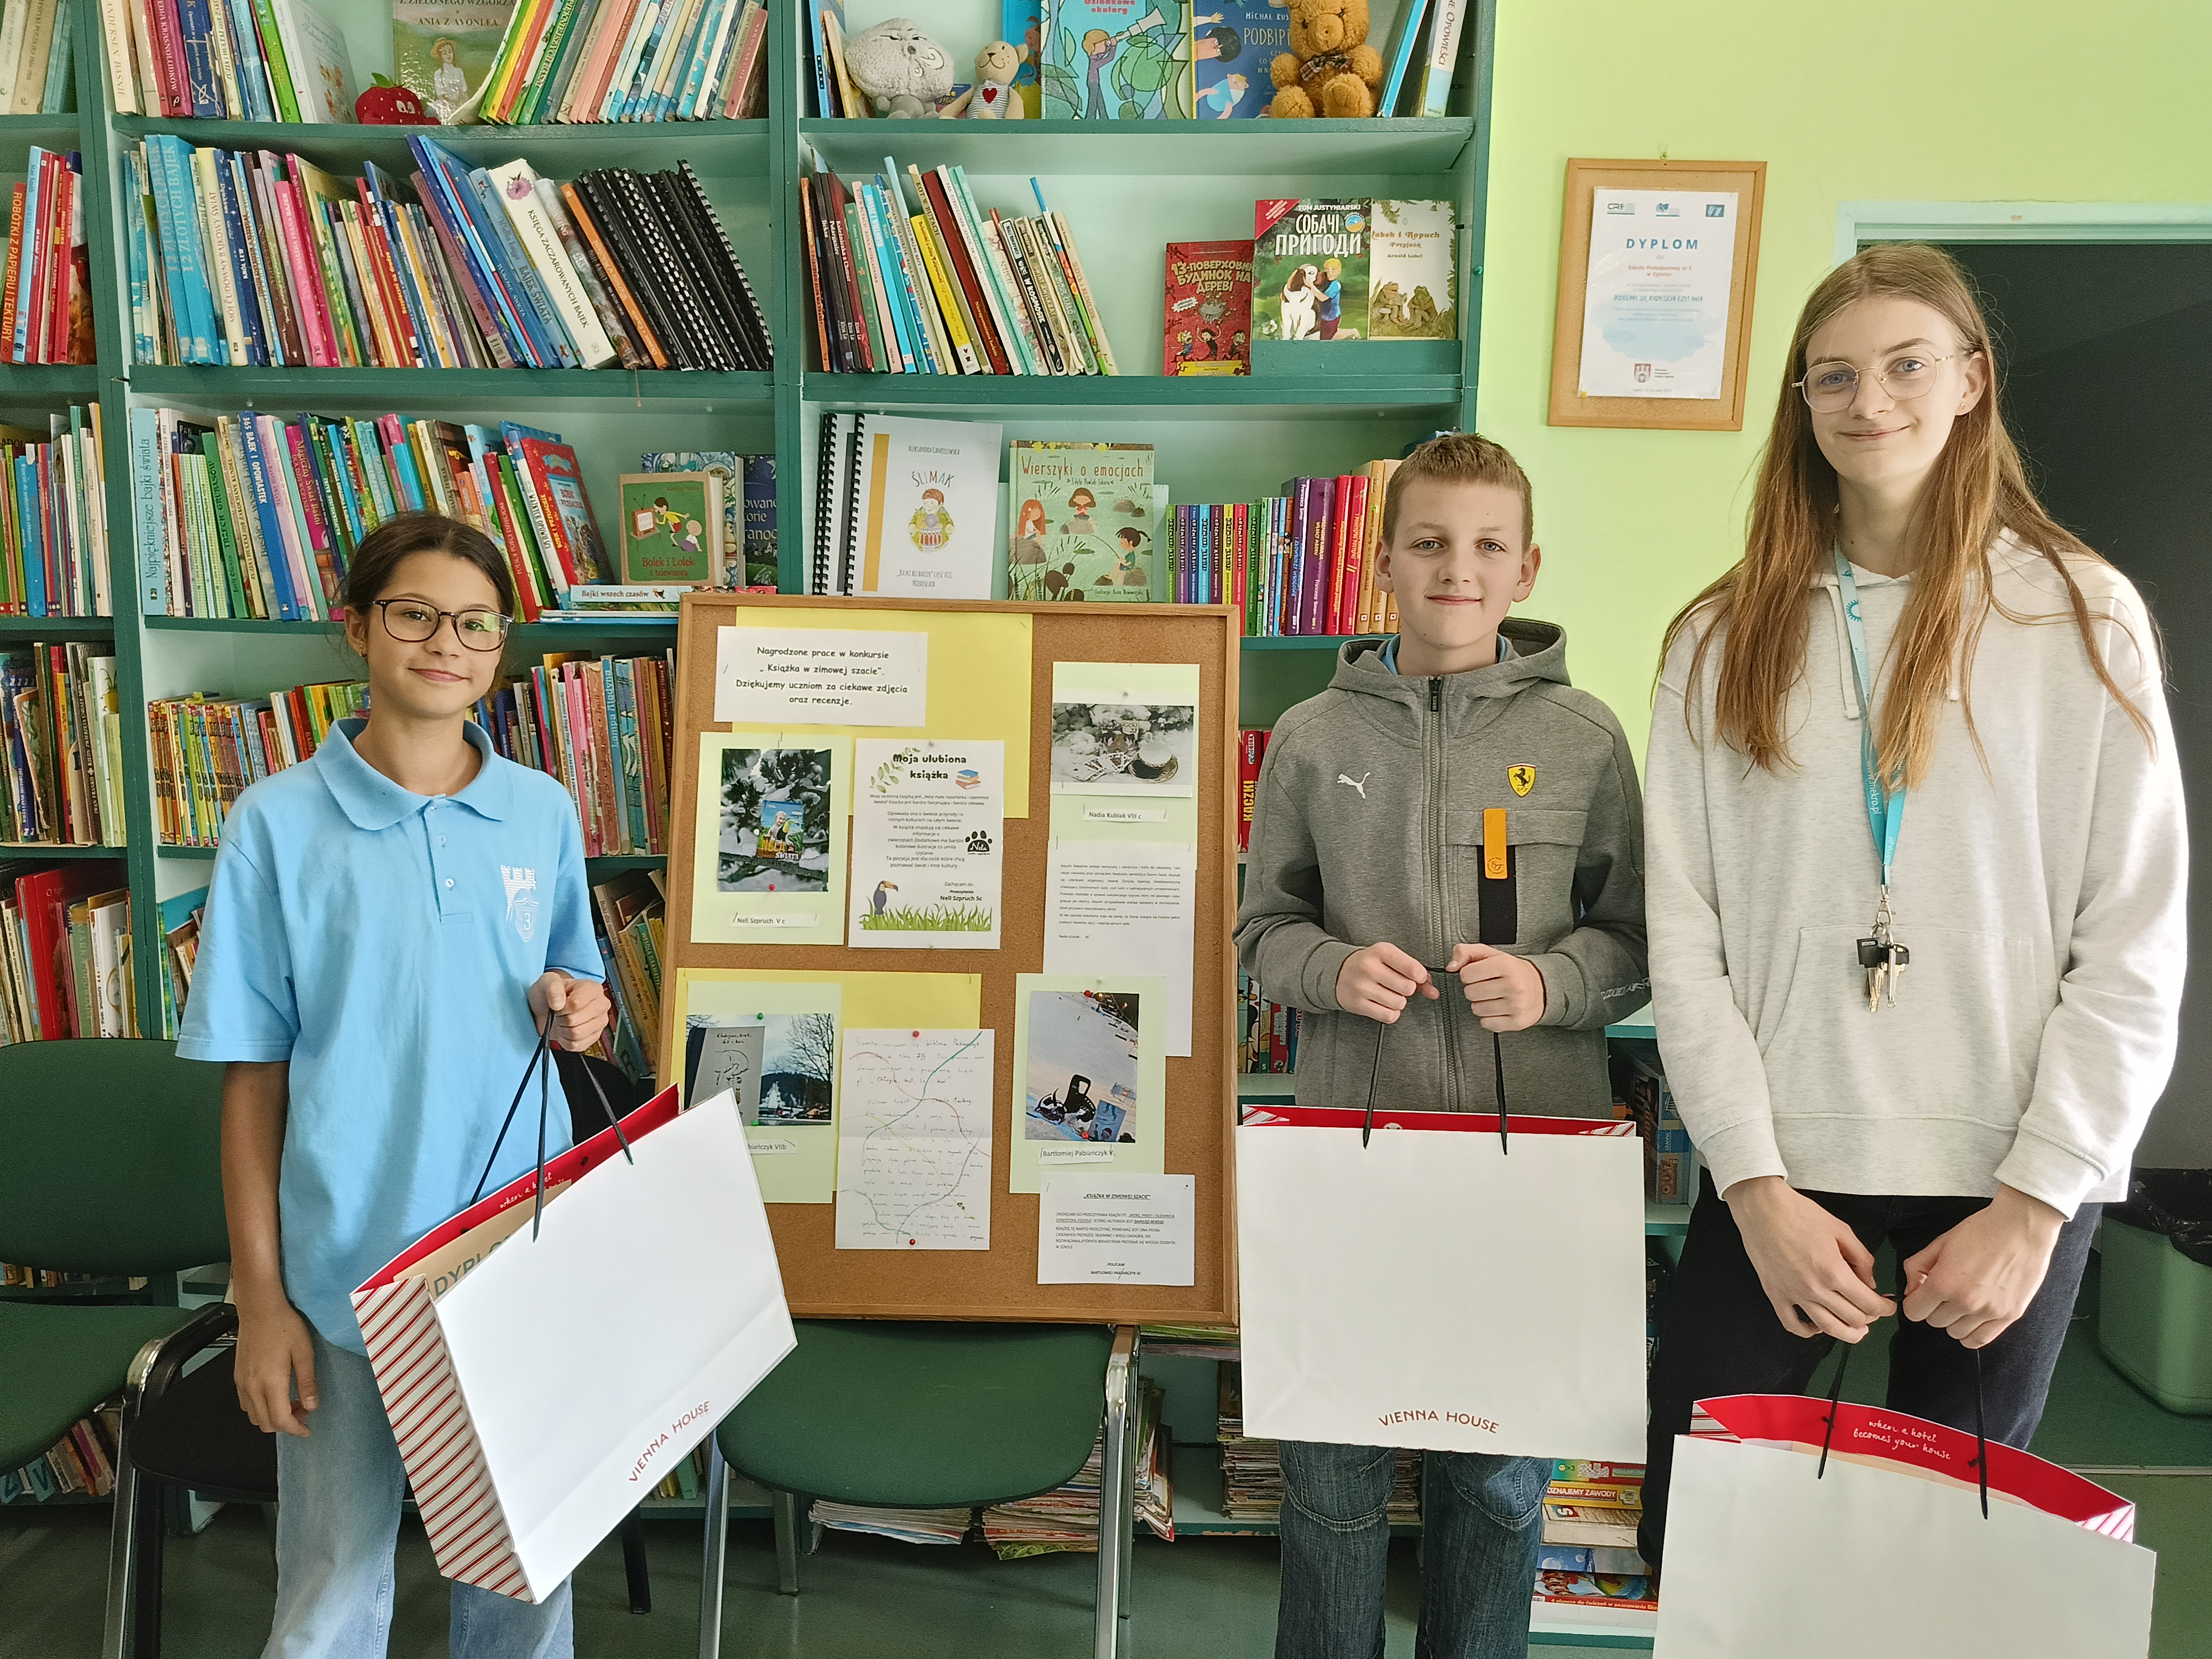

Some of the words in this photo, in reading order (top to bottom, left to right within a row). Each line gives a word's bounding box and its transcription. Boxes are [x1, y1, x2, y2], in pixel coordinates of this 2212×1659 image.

[106, 0, 119, 56] ANDERSEN
[114, 61, 125, 97] BAŚNIE
[1438, 11, 1455, 66] OPOWIEŚCI
[161, 22, 177, 91] KRASNOLUDKÓW
[163, 145, 181, 184] BAJEK
[9, 192, 23, 236] ROBÓTKI
[208, 191, 220, 217] ŚWIAT
[915, 182, 925, 197] KOT
[924, 207, 940, 236] BUTACH
[169, 188, 190, 256] ZŁOTYCH
[1296, 214, 1339, 233] СОБАЧІ
[215, 219, 228, 258] BAJKOWY
[830, 221, 840, 255] Potarganiec
[1275, 234, 1361, 258] ПРИГОДИ
[1405, 231, 1440, 239] Ropuch
[1626, 238, 1698, 250] DYPLOM
[835, 221, 846, 256] Księżniczka
[842, 261, 851, 282] Chmur
[6, 247, 18, 290] PAPIERU
[181, 258, 194, 272] 12
[527, 210, 544, 238] KSIĘGA
[541, 238, 578, 305] ZACZAROWANYCH
[573, 306, 588, 328] BAJEK
[220, 260, 234, 304] CUDOWNY
[1177, 269, 1233, 286] БУДИНОК
[1235, 271, 1251, 283] НА
[1196, 280, 1234, 294] ДЕРЕВІ
[519, 267, 535, 289] BAJEK
[532, 290, 552, 325] ŚWIATA
[1027, 286, 1045, 324] KOSMOSIE
[2, 296, 14, 341] TEKTURY
[226, 307, 236, 323] MÓJ
[243, 416, 252, 430] 365
[246, 432, 256, 452] BAJEK
[139, 439, 151, 471] świata
[294, 440, 310, 477] Magiczny
[911, 470, 954, 488] ŚLIMAK
[1021, 455, 1072, 480] Wierszyki
[1081, 466, 1086, 476] o
[1094, 458, 1143, 481] emocjach
[139, 474, 153, 500] bajki
[252, 462, 267, 504] OPOWIASTEK
[305, 480, 316, 502] Świat
[310, 503, 322, 526] Baśni
[529, 494, 542, 519] WAŻNYCH
[536, 520, 551, 550] OPOWIEŚCI
[143, 504, 160, 578] Najpiękniejsze
[642, 557, 665, 567] Bolek
[667, 557, 670, 567] i
[672, 557, 695, 567] Lolek
[581, 588, 600, 599] Bajki
[602, 589, 624, 598] wszech
[625, 589, 649, 598] czasów
[757, 646, 808, 657] Nagrodzone
[849, 650, 889, 659] konkursie
[768, 663, 800, 673] Książka
[813, 665, 848, 676] zimowej
[851, 667, 885, 675] szacie”.
[604, 670, 615, 712] Aladyna
[736, 679, 785, 690] Dziękujemy
[877, 685, 907, 694] zdjęcia
[812, 697, 853, 706] recenzje.
[611, 713, 619, 748] Lampa
[893, 754, 919, 764] Moja
[922, 754, 967, 763] ulubiona
[910, 770, 948, 781] książka
[761, 838, 786, 853] NELA
[970, 842, 987, 851] Nela
[524, 912, 531, 931] 3
[748, 1142, 773, 1151] biańczyk
[1043, 1150, 1074, 1158] Bartłomiej
[1074, 1150, 1108, 1159] Pabiańczyk
[1378, 1410, 1439, 1426] VIENNA
[1447, 1411, 1499, 1434] HOUSE
[1869, 1420, 1898, 1433] when
[1911, 1428, 1937, 1443] hotel
[628, 1432, 670, 1483] VIENNA
[671, 1401, 711, 1434] HOUSE
[1853, 1428, 1891, 1443] becomes
[1891, 1438, 1919, 1451] your
[1923, 1443, 1951, 1459] house
[1585, 1489, 1616, 1498] ZAWODY
